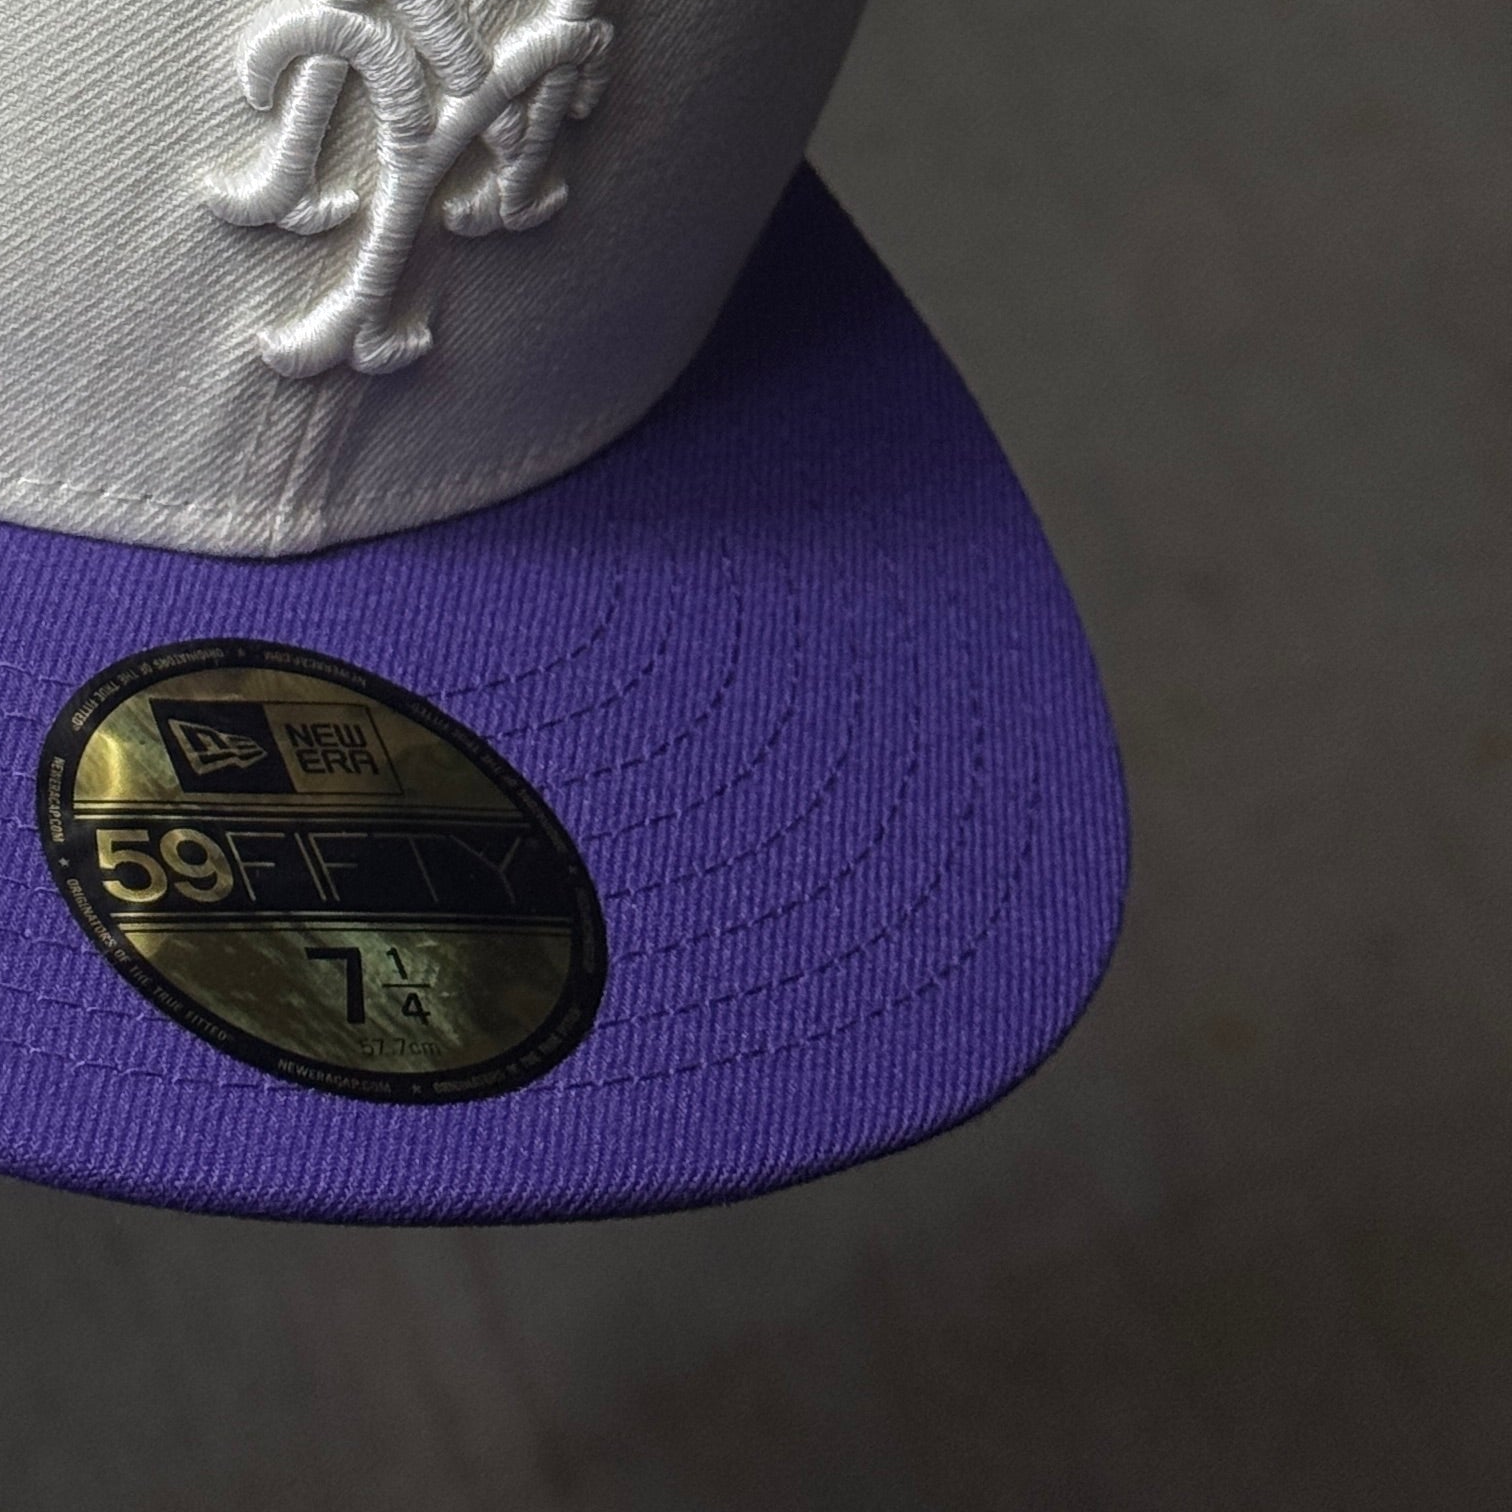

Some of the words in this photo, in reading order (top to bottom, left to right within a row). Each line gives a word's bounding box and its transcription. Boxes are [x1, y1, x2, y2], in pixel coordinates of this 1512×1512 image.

[285, 722, 367, 748] NEW
[295, 748, 380, 775] ERA
[47, 755, 66, 844] NEWERACAP.COM
[95, 826, 522, 904] 59FIFTY
[65, 877, 118, 949] ORIGINATORS
[304, 946, 366, 1025] 7
